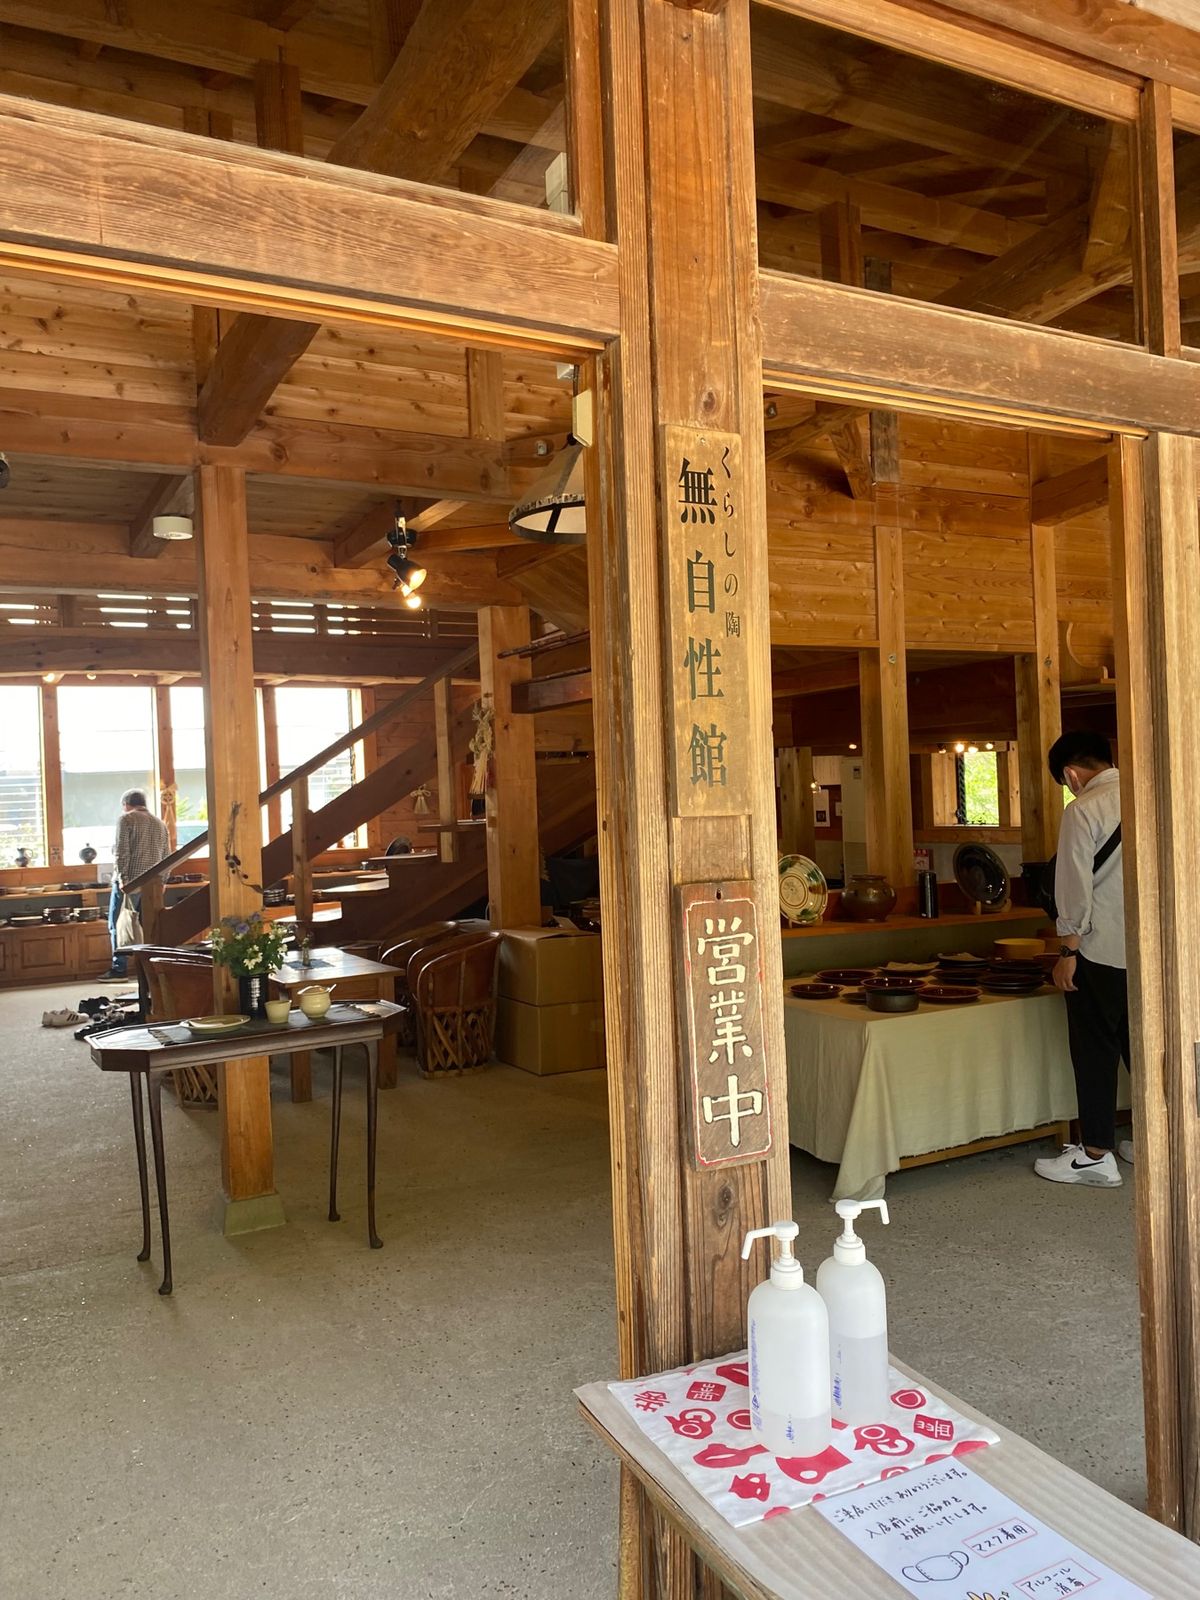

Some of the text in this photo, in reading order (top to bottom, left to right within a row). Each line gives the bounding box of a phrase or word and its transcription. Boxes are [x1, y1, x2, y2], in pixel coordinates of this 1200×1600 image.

[720, 446, 741, 638] くらしの陶
[678, 457, 728, 788] 無自性館
[697, 916, 764, 1147] 営業中
[972, 1524, 1028, 1552] マスク着用
[1020, 1567, 1071, 1592] アルコール
[1055, 1576, 1085, 1596] 消毒
